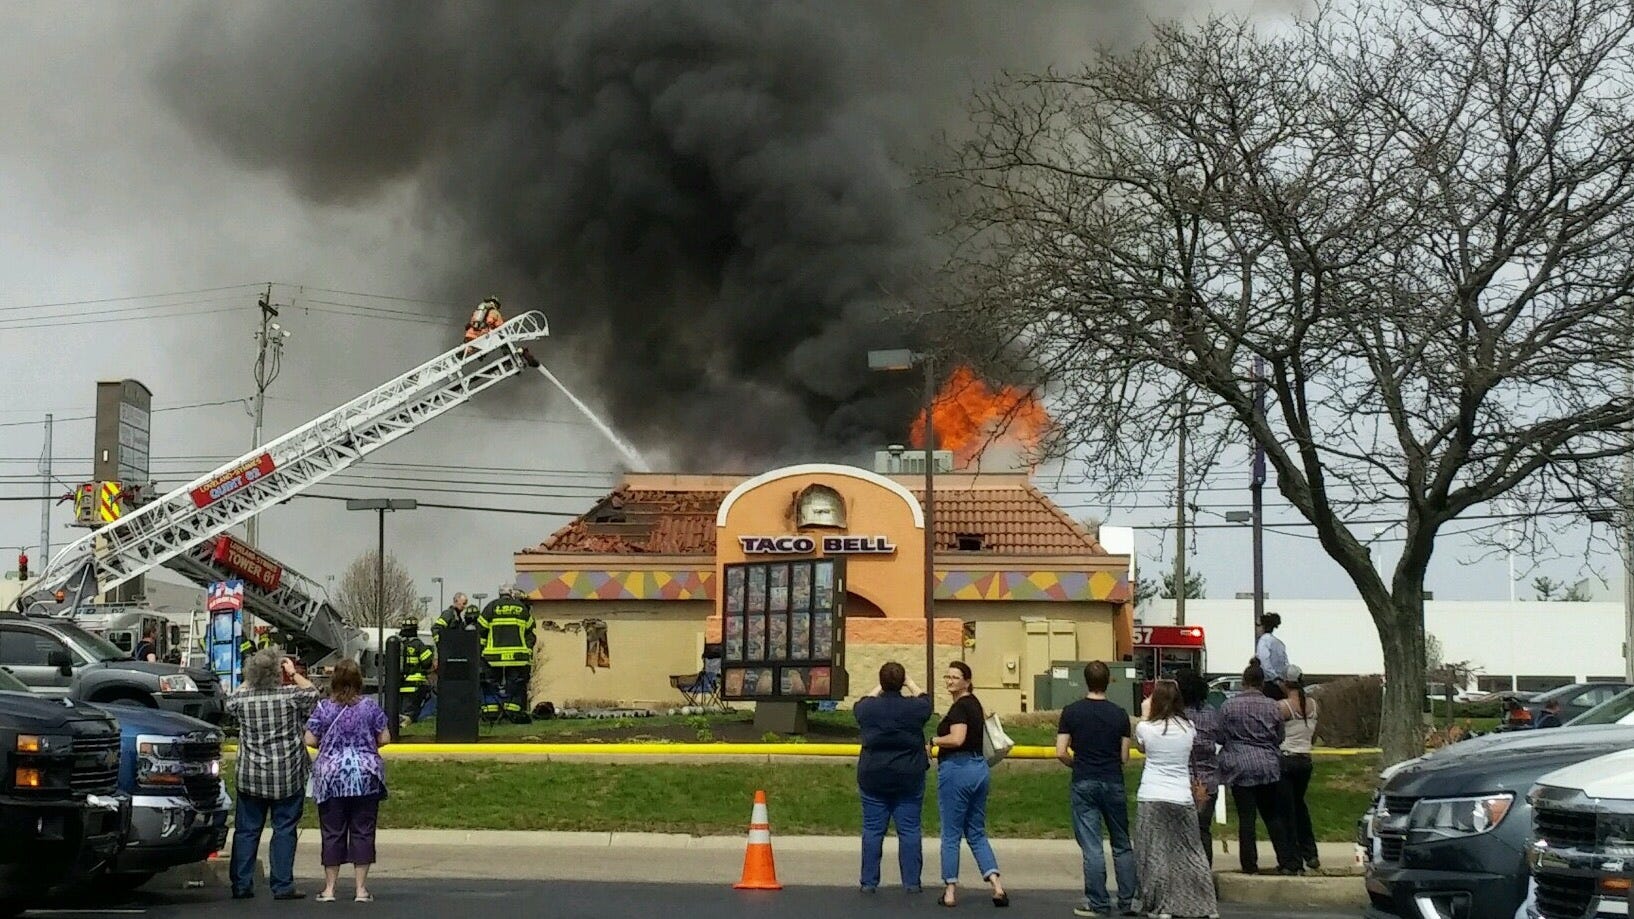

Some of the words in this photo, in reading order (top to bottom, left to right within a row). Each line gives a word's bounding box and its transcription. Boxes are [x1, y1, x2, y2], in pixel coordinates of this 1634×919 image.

[209, 475, 243, 499] QUINT
[740, 536, 814, 552] TACO
[823, 536, 896, 552] BELL
[228, 549, 262, 578] TOWER
[263, 571, 276, 585] 61
